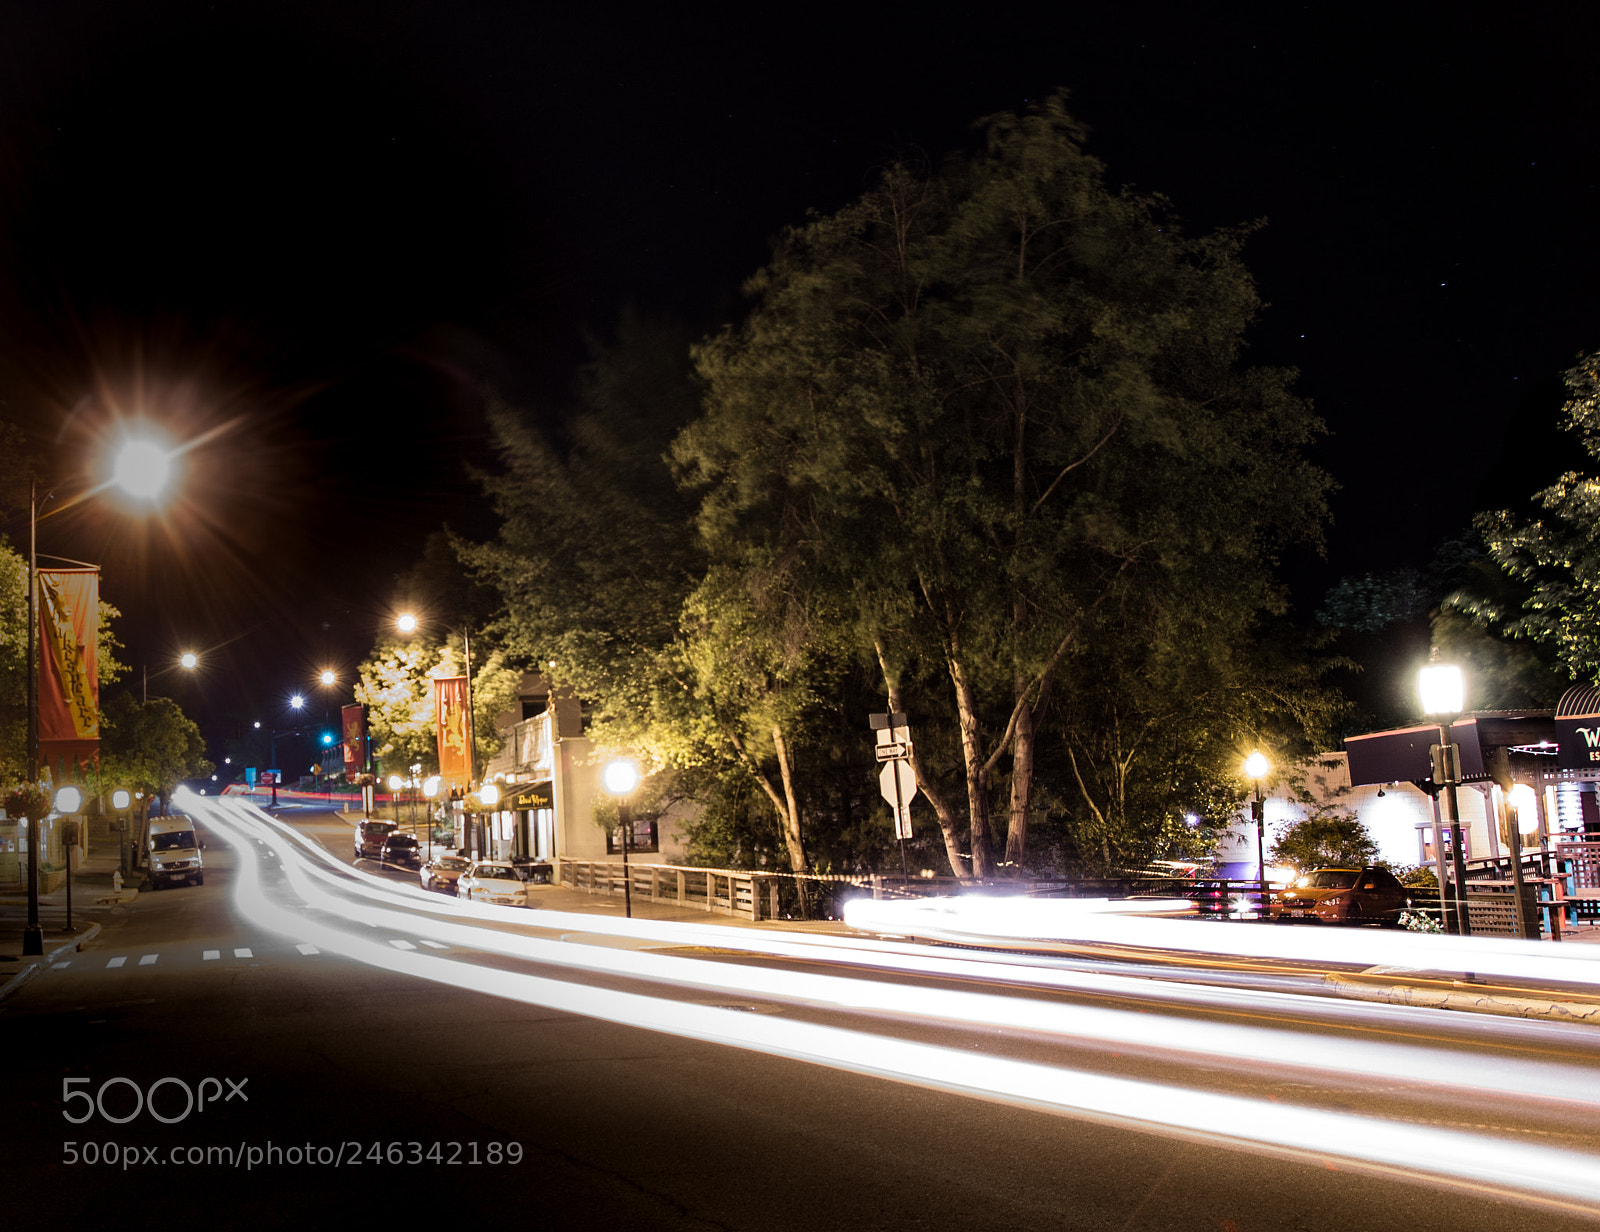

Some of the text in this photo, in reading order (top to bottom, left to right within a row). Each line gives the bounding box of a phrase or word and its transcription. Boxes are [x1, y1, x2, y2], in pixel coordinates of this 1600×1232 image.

[1575, 727, 1600, 748] W
[878, 747, 898, 756] ONE WAY
